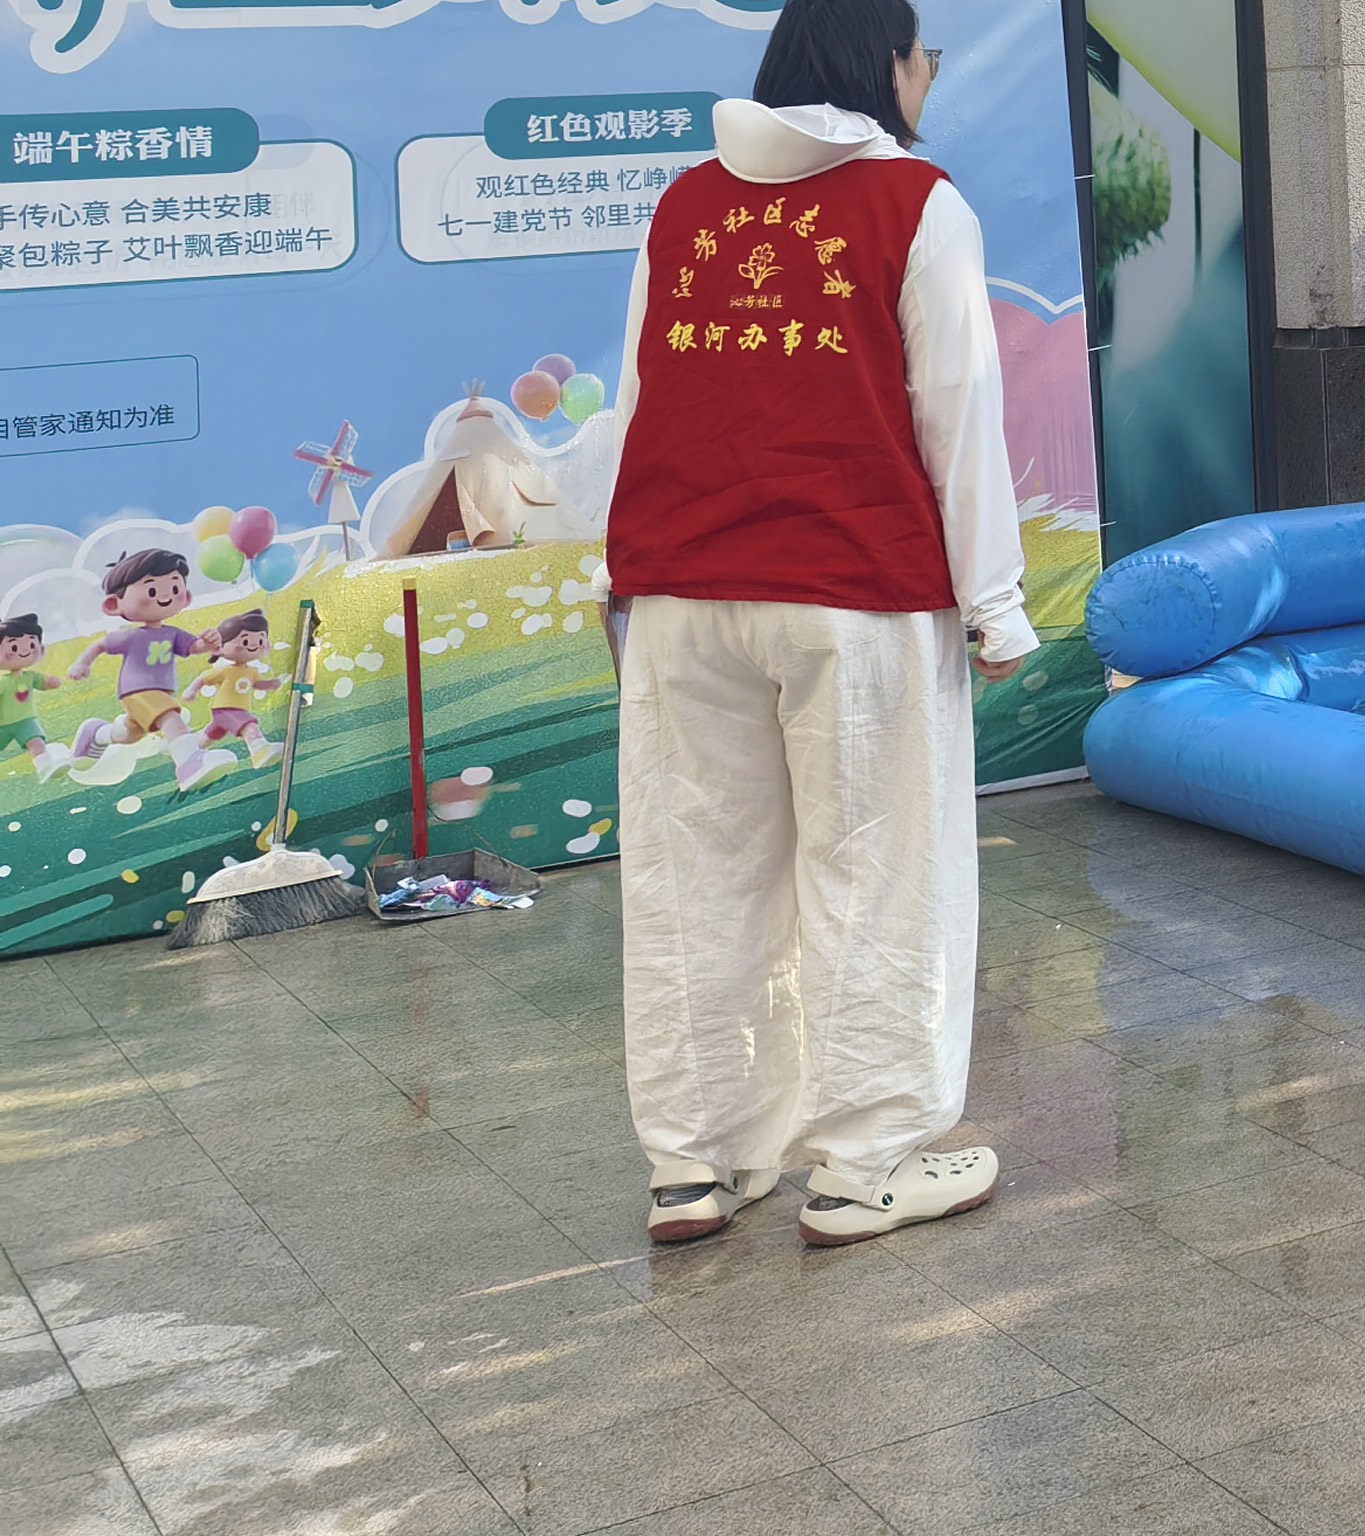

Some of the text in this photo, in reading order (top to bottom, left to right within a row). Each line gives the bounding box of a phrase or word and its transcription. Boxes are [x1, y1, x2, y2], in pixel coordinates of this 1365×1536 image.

[527, 108, 693, 144] 红色观影季
[13, 125, 213, 166] 端午粽香情
[475, 169, 610, 199] 观红色经典
[121, 192, 272, 225] 合美共安康
[437, 201, 656, 237] 七一建党节 邻里共
[123, 226, 333, 263] 艾叶飘香迎端午
[666, 318, 848, 357] 银河办事处
